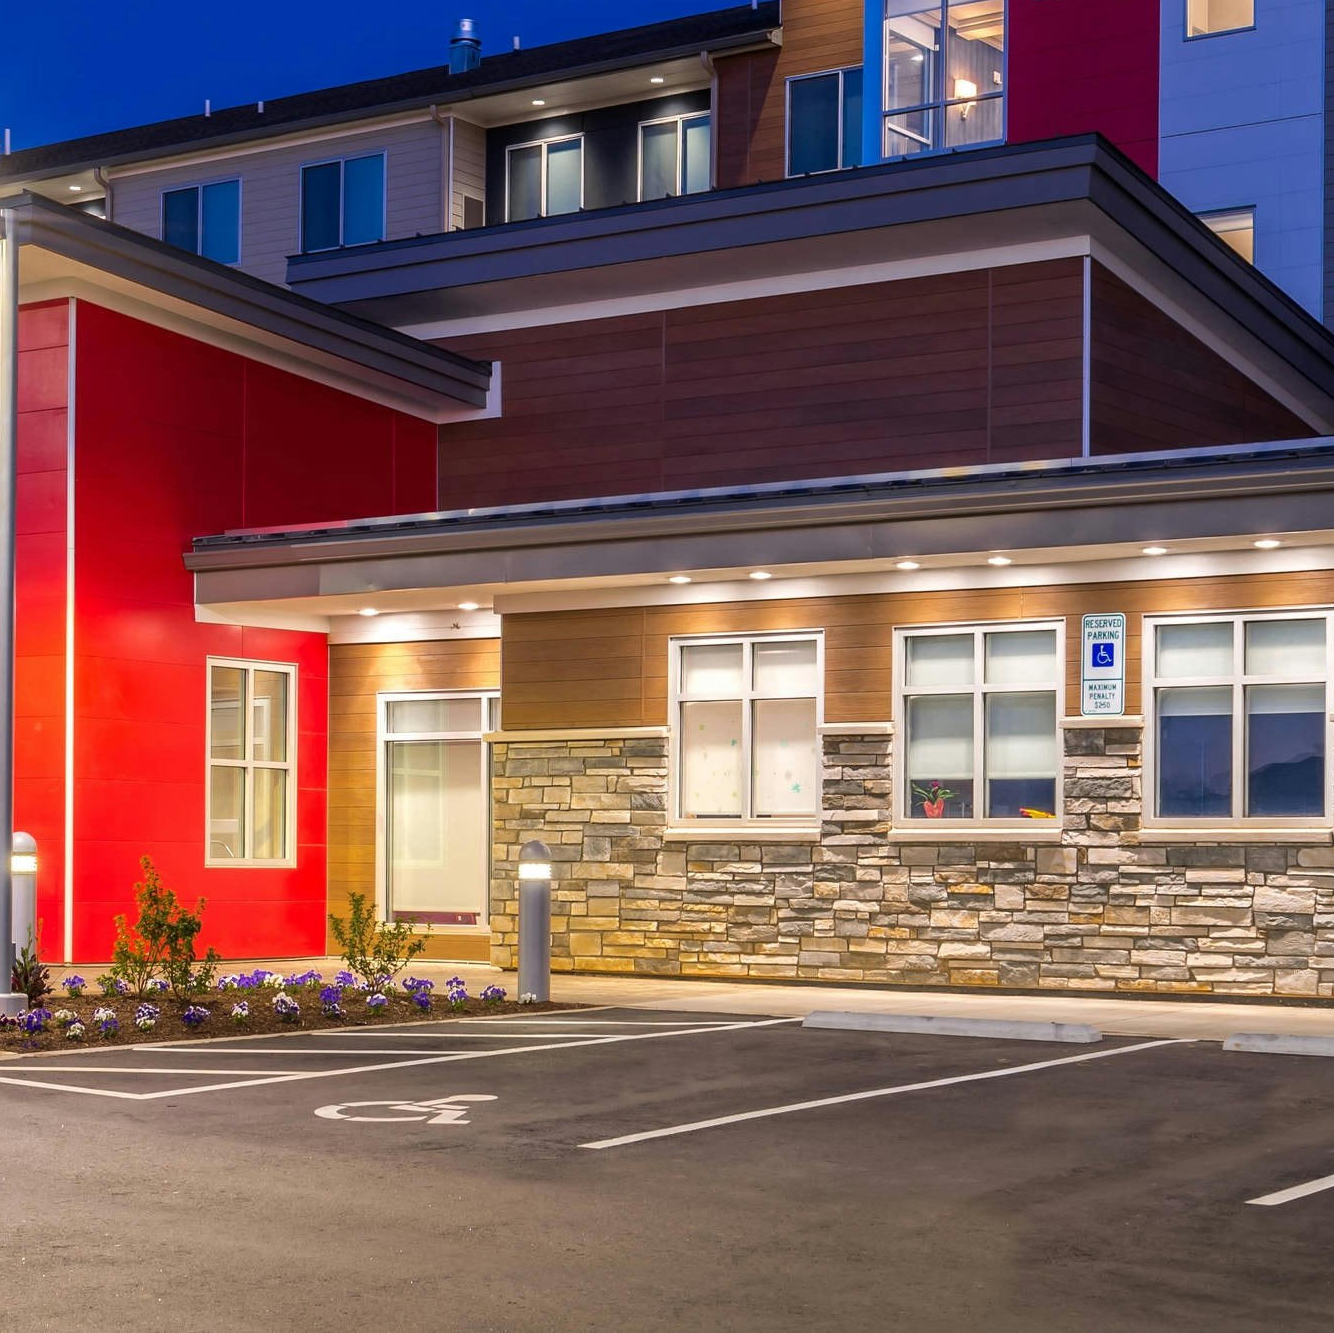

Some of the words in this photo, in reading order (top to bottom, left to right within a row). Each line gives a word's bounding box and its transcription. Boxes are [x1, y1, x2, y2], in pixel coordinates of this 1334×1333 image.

[1085, 618, 1122, 629] RESERVED
[1087, 630, 1120, 640] PARKING
[1088, 683, 1117, 691] MAXIMUM
[1089, 692, 1116, 700] PENALTY
[1094, 701, 1111, 709] $250
